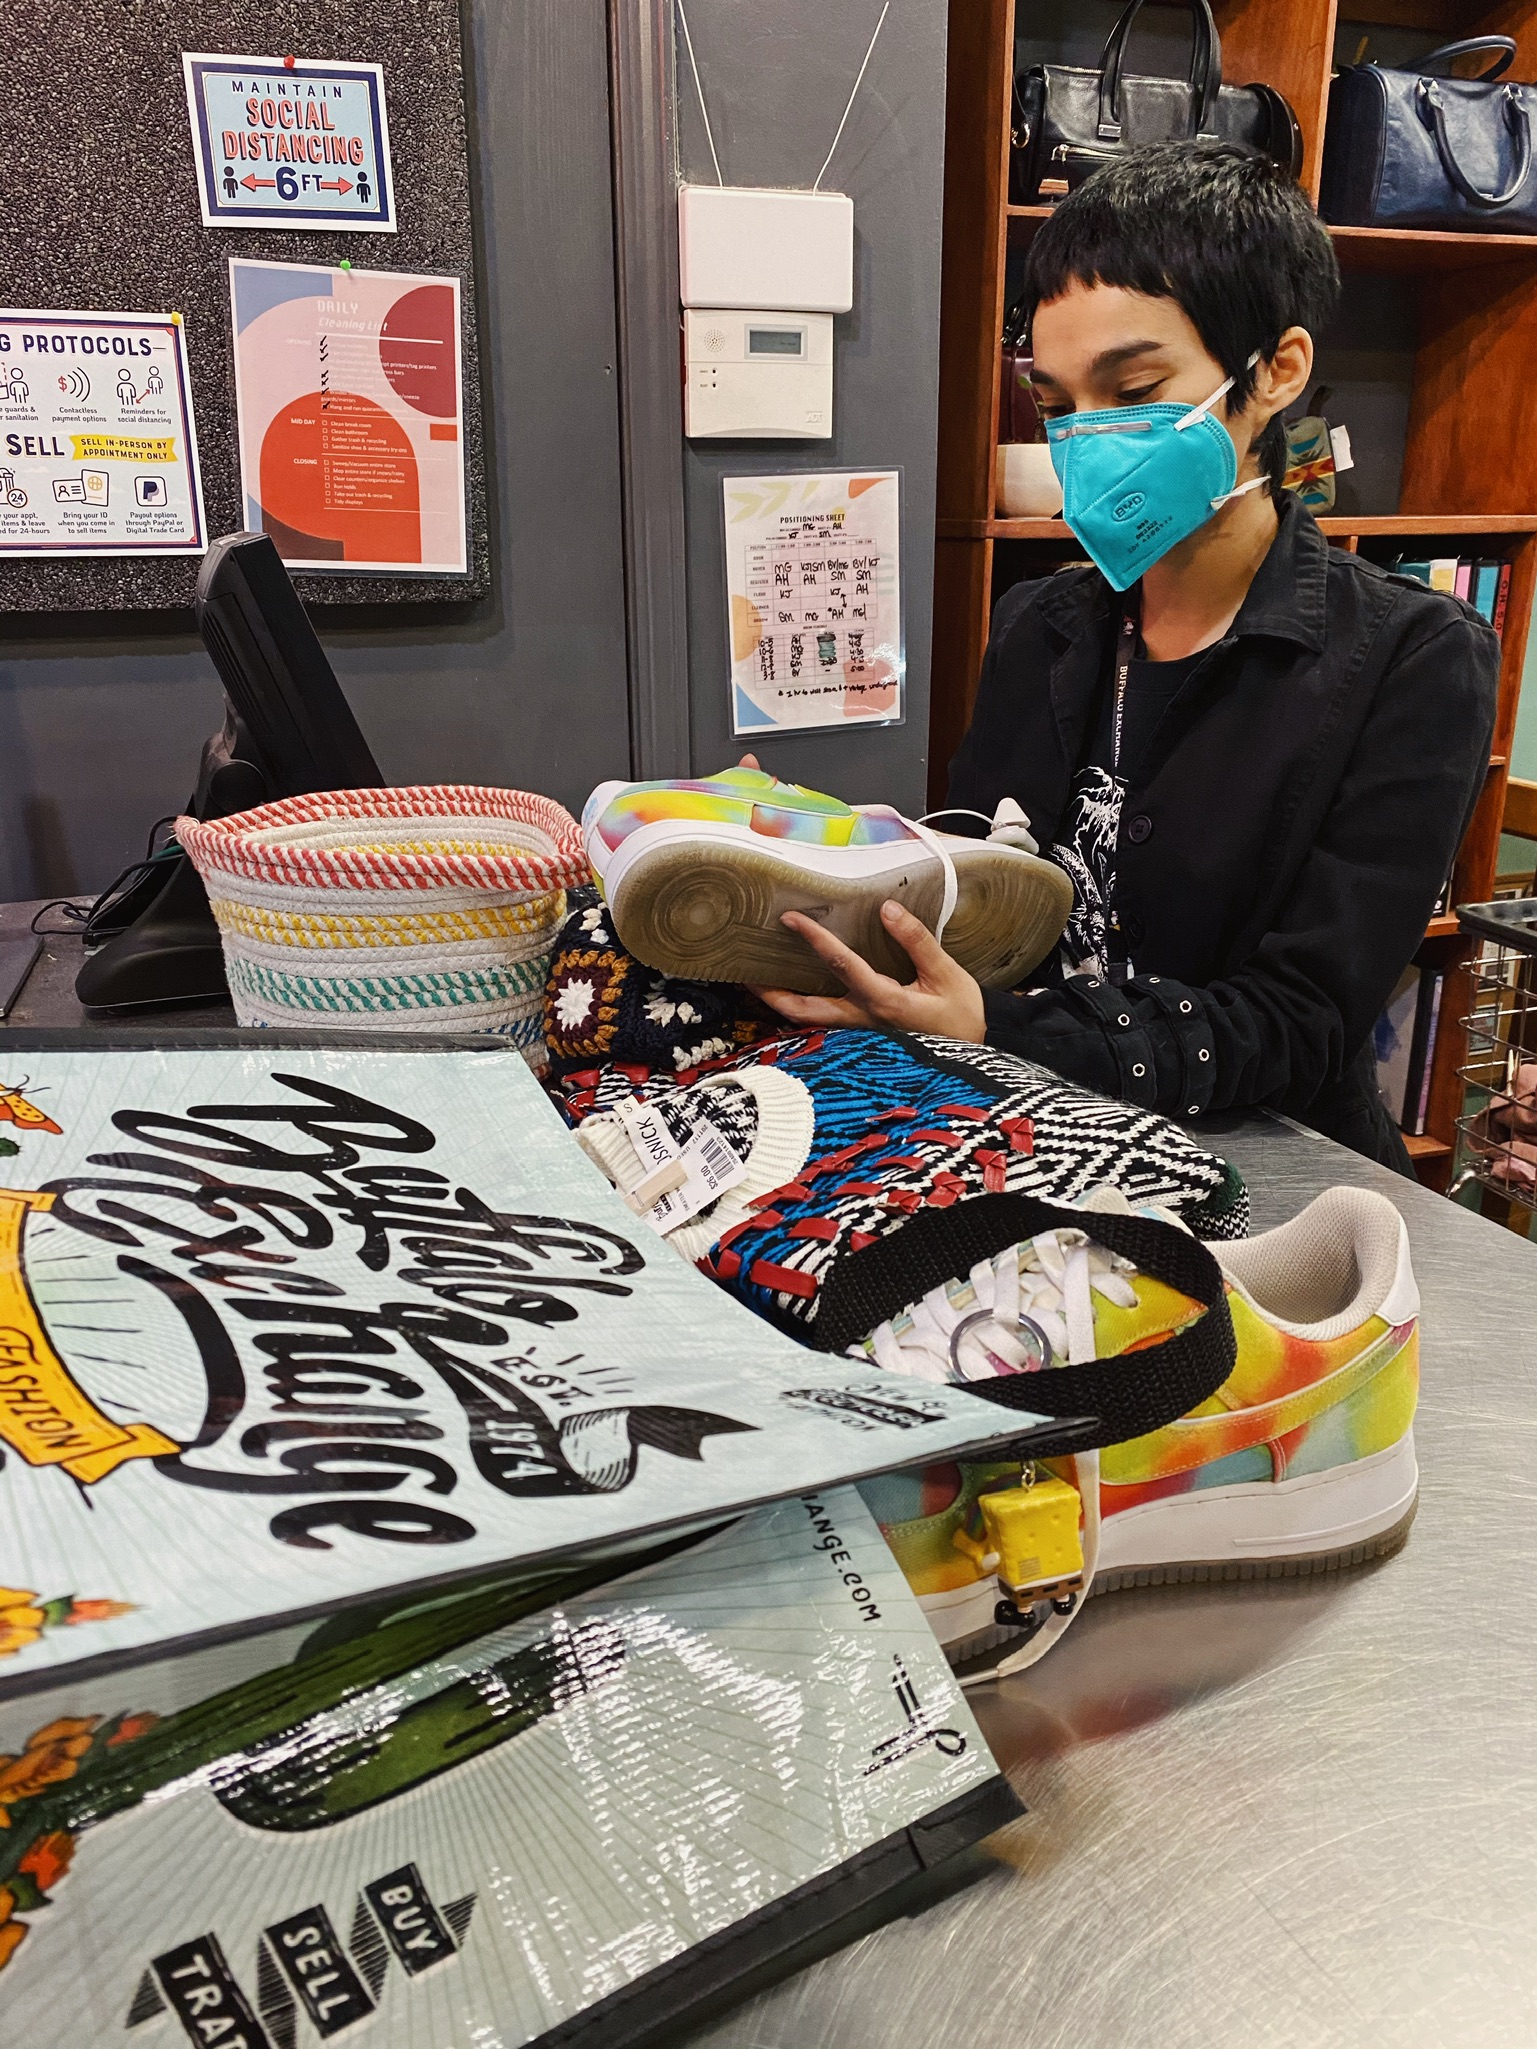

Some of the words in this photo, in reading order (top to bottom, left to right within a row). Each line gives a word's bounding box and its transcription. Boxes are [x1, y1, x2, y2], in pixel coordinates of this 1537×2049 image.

[232, 81, 342, 98] MAINTAIN
[246, 97, 335, 130] SOCIAL
[222, 131, 364, 165] DISTANCING
[275, 167, 299, 201] 6
[302, 174, 322, 192] FT
[317, 300, 359, 315] DAILY
[319, 317, 365, 330] Cleaning
[367, 319, 388, 331] List
[23, 334, 151, 356] PROTOCOLS
[5, 406, 28, 414] guards
[6, 434, 65, 456] SELL
[83, 449, 144, 459] APPOINTMENT
[106, 439, 153, 448] IN-PERSON
[10, 493, 23, 502] 24
[1115, 496, 1143, 518] BYD
[780, 515, 824, 523] POSITIONING
[701, 1165, 719, 1190] $26.00
[112, 1073, 647, 1348] Buffalo
[38, 1152, 477, 1549] Exchange
[0, 1324, 92, 1450] FASHION
[484, 1419, 559, 1480] 1974
[380, 1883, 439, 1951] BUY
[281, 1925, 351, 2022] SELL
